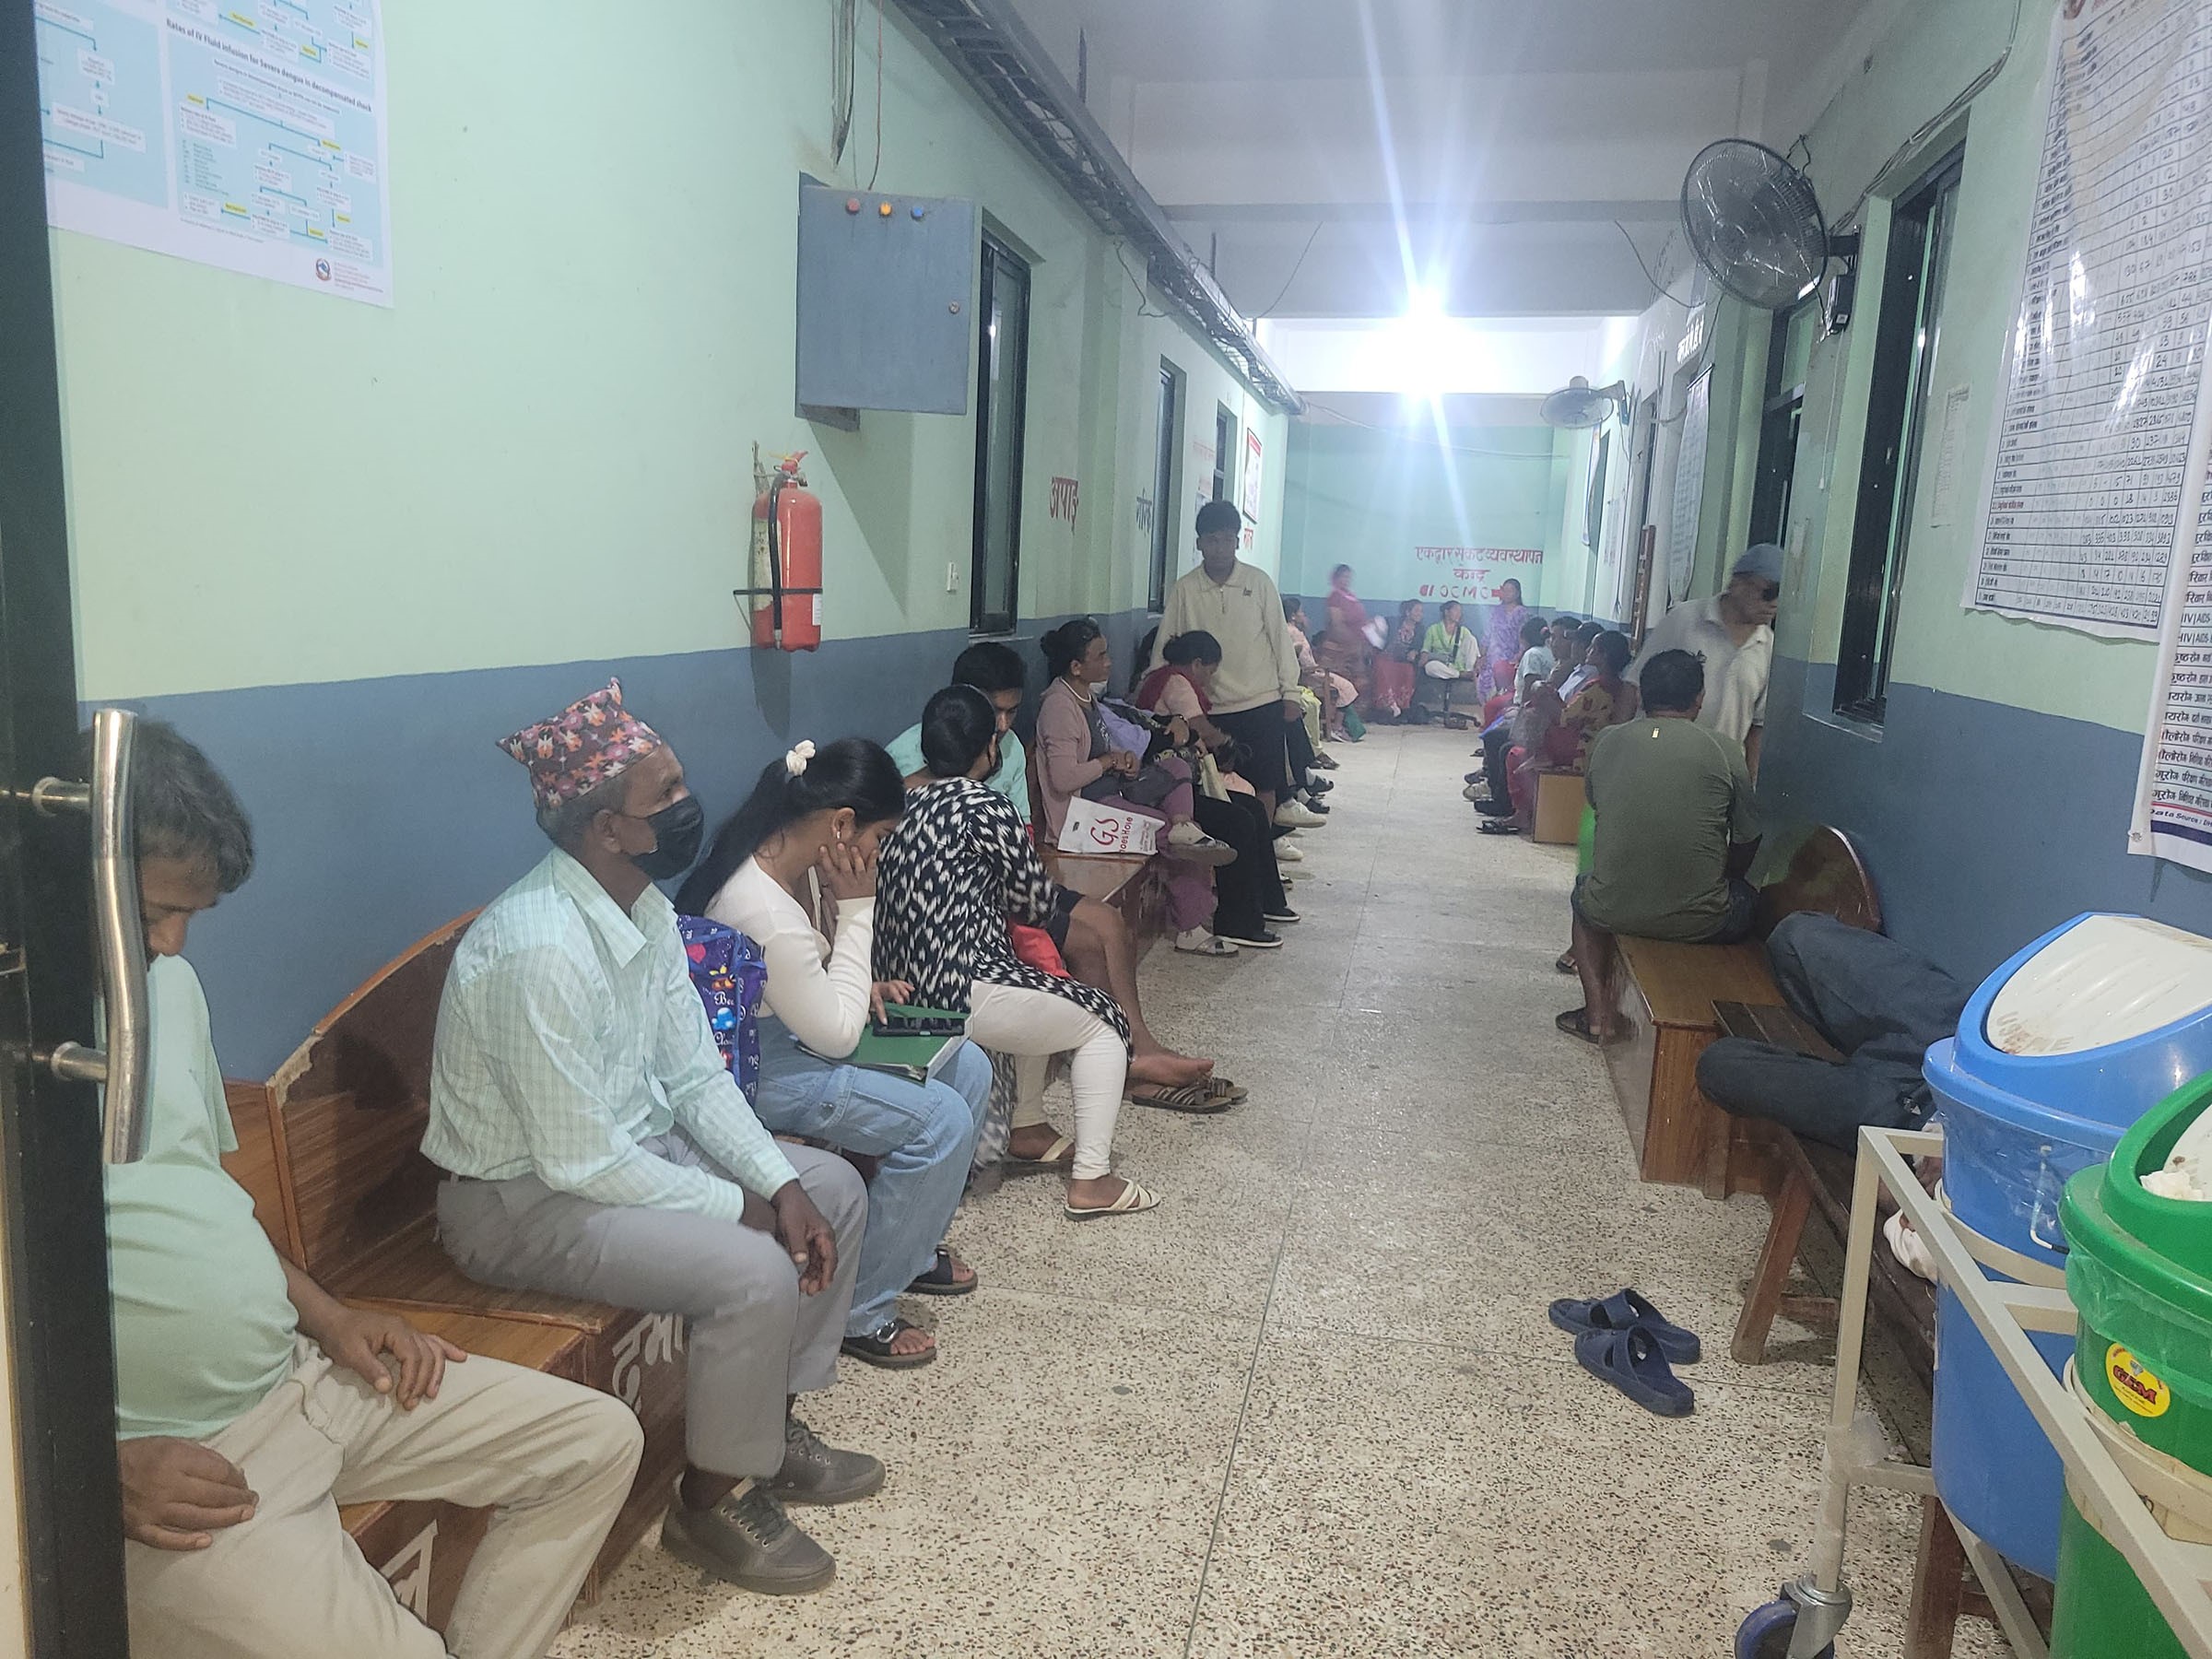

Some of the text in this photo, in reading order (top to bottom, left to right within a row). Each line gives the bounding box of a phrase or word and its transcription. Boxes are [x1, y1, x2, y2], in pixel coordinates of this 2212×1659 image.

[166, 18, 185, 34] Rates
[204, 35, 221, 49] Fluid
[222, 42, 249, 62] infusion
[260, 58, 280, 74] Severe
[281, 68, 304, 83] dengue
[312, 81, 356, 106] decompensated
[357, 99, 372, 112] shock
[2176, 813, 2198, 824] Source
